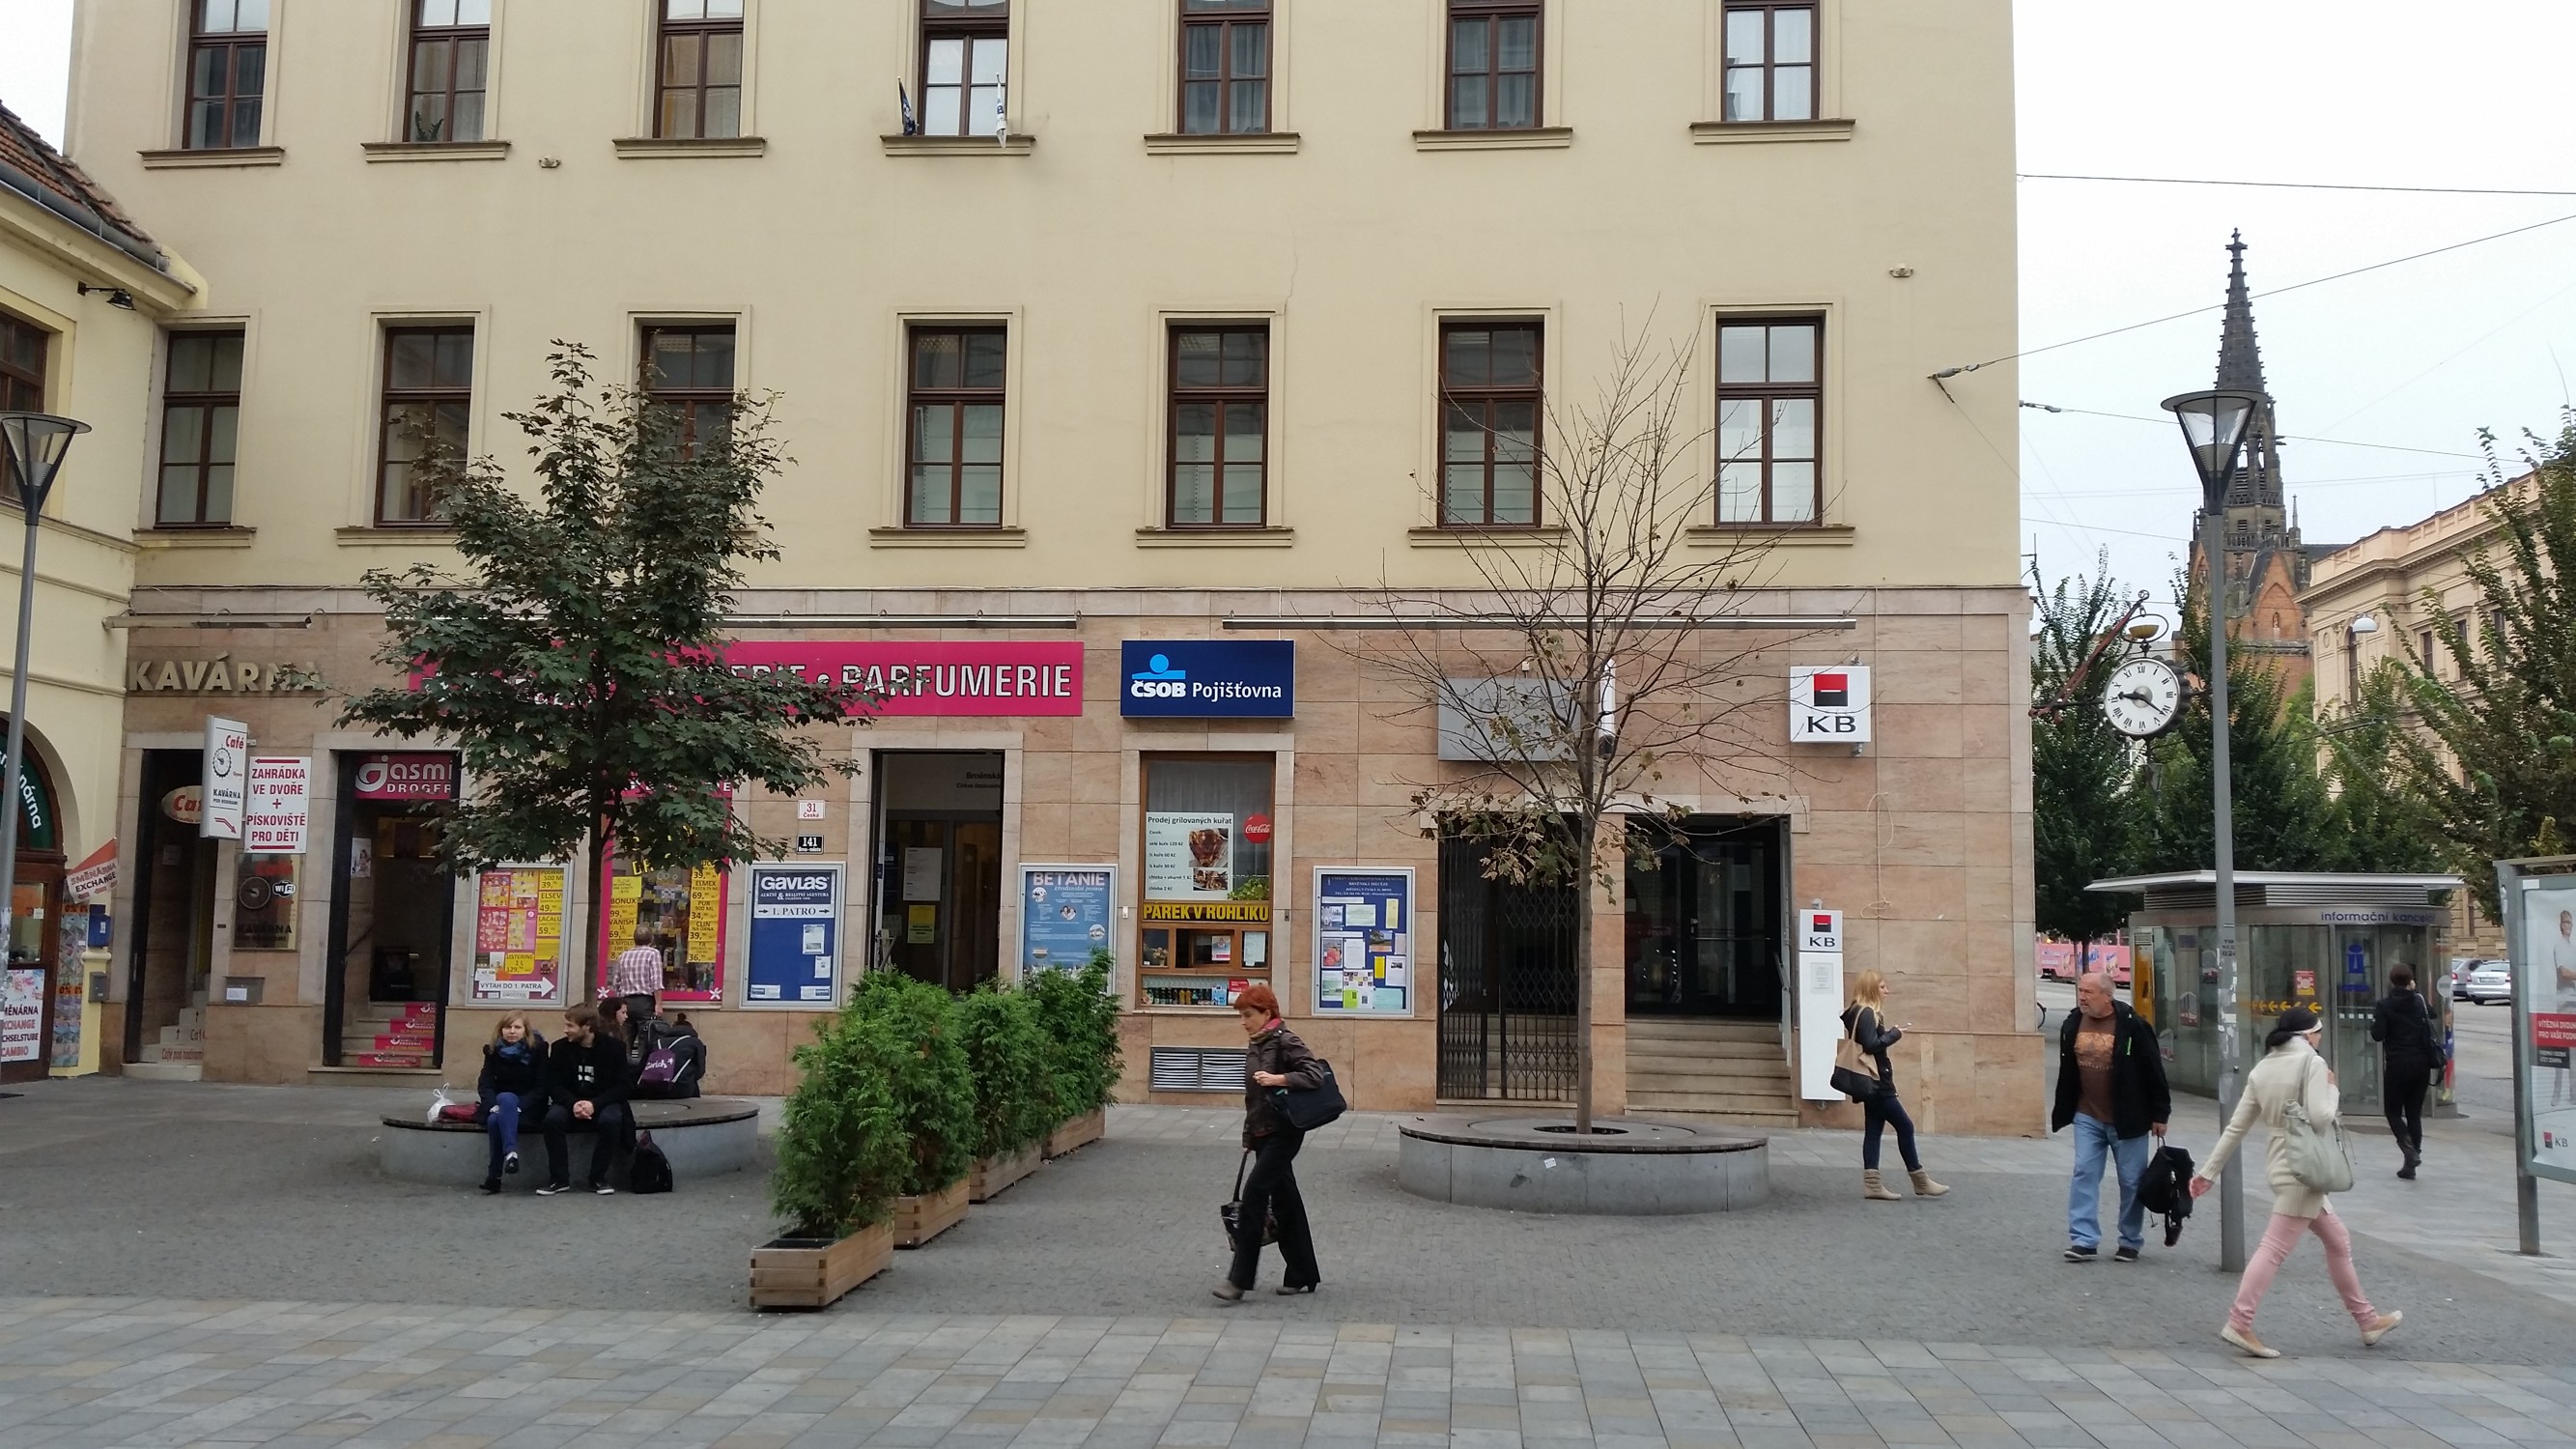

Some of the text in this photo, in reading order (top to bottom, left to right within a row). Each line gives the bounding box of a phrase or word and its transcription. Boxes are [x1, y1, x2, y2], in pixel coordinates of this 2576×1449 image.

[128, 650, 325, 692] KAVÁRNA
[1131, 680, 1282, 702] ČSOB Pojišťovna
[1806, 715, 1856, 733] KB
[225, 734, 244, 750] Café
[252, 766, 305, 780] ZAHRÁDKA
[212, 788, 241, 800] KAVÁRNA
[253, 781, 303, 795] VE DVOŘE
[807, 803, 816, 812] 31
[246, 812, 305, 826] PÍSKOVIŠTĚ
[1172, 816, 1212, 825] grilovaných
[252, 828, 298, 841] PRO DĚTI
[802, 837, 818, 846] 141
[75, 871, 117, 893] EXCHANGE
[1033, 872, 1105, 886] BETANIE
[1143, 901, 1268, 921] PÁREK V ROHLÍKU
[2321, 911, 2389, 922] informační
[1809, 936, 1835, 948] KB
[5, 1005, 39, 1016] ĚNÁRNA
[1, 1019, 36, 1030] XCHANGE
[1, 1033, 39, 1043] CHSELSTUBE
[2555, 1138, 2568, 1148] KB
